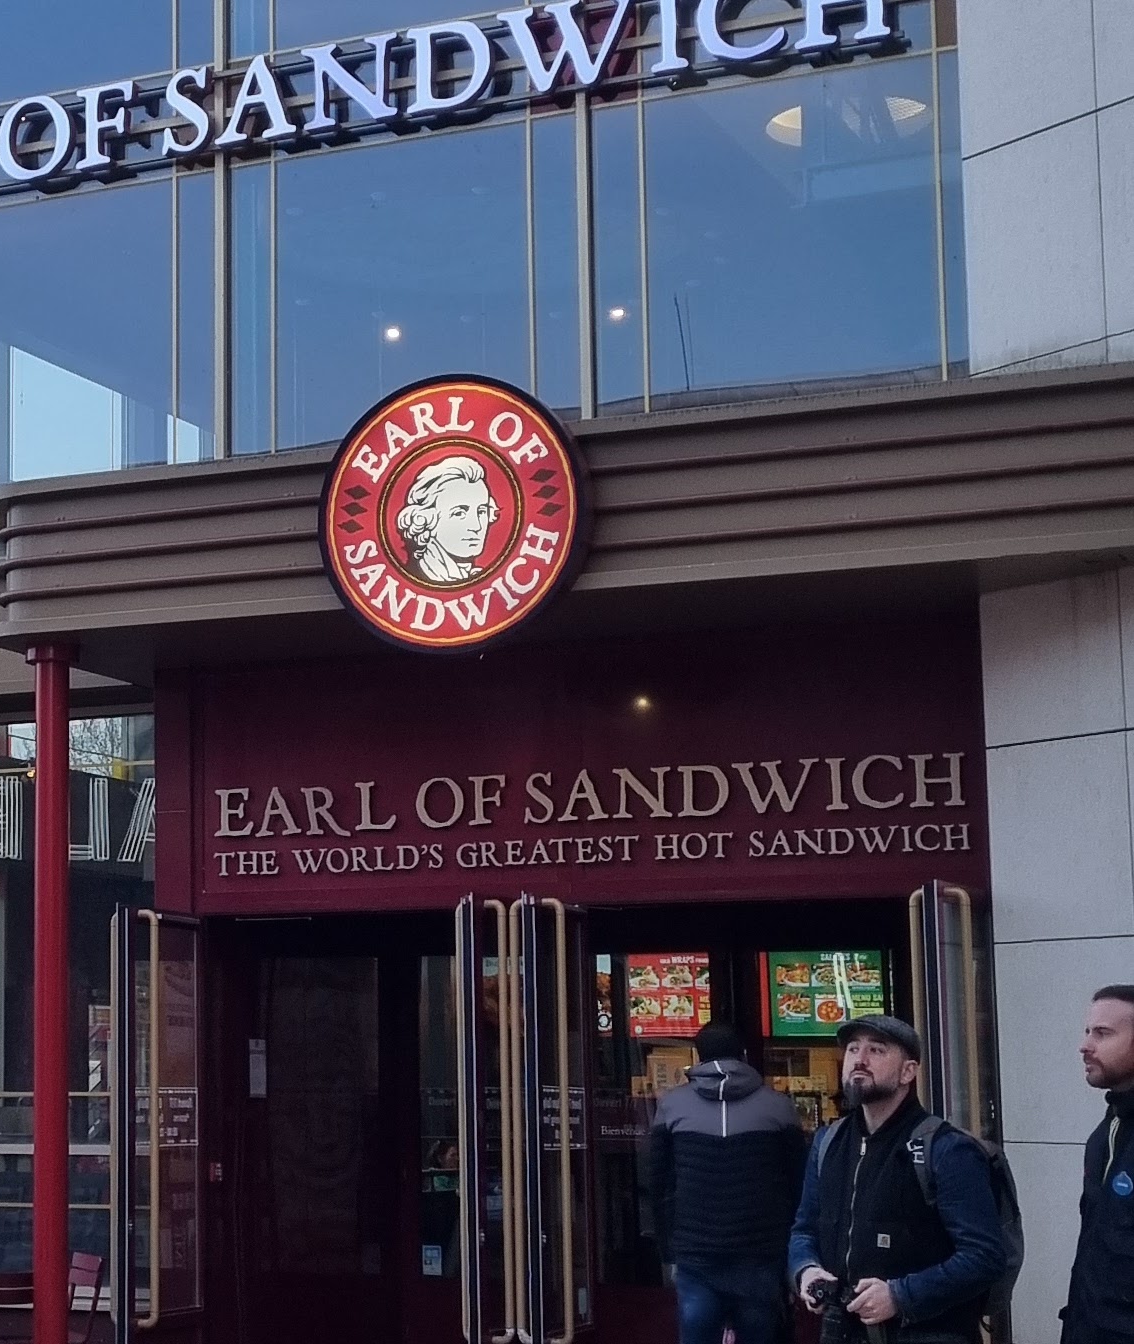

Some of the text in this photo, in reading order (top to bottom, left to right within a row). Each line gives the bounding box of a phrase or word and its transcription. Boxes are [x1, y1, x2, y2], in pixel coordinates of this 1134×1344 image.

[352, 396, 549, 483] EARL OF
[344, 523, 560, 632] SANDWICH
[214, 781, 396, 837] EARL
[415, 774, 506, 829] OF
[524, 752, 965, 824] SANDWICH
[214, 823, 971, 876] THE WORLD'S GREATEST HOT SANDWICH
